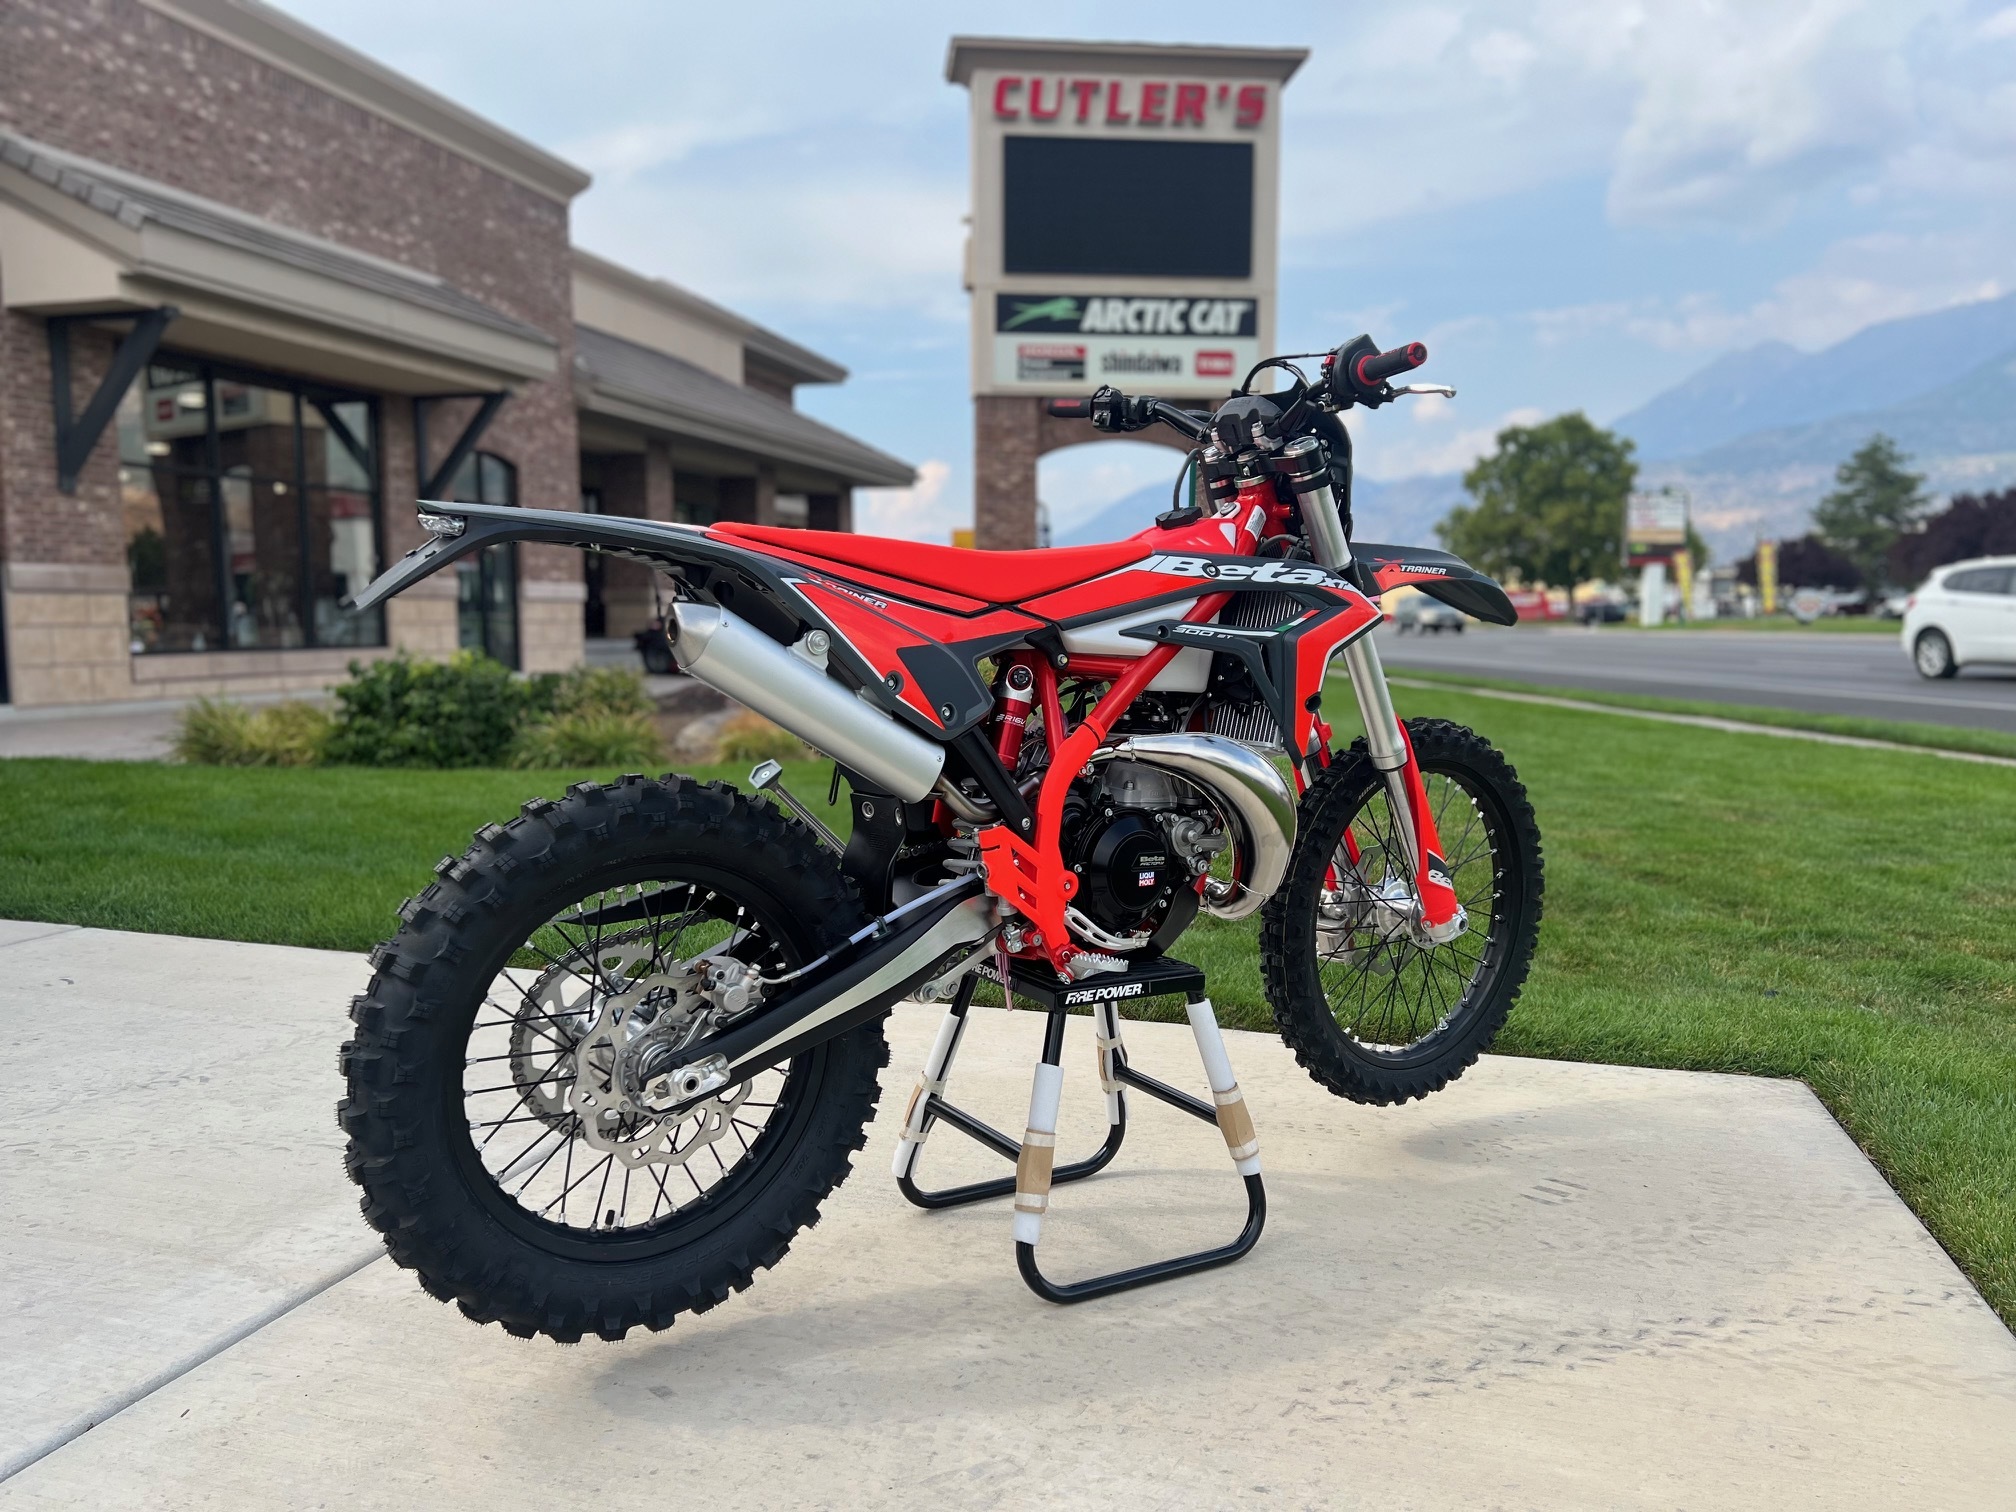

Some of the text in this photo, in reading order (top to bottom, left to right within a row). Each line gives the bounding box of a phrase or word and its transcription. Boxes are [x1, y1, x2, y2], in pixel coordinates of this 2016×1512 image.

[993, 77, 1268, 126] CUTLER'S
[1079, 298, 1252, 335] ARCTIC CAT
[1151, 555, 1328, 586] Beta
